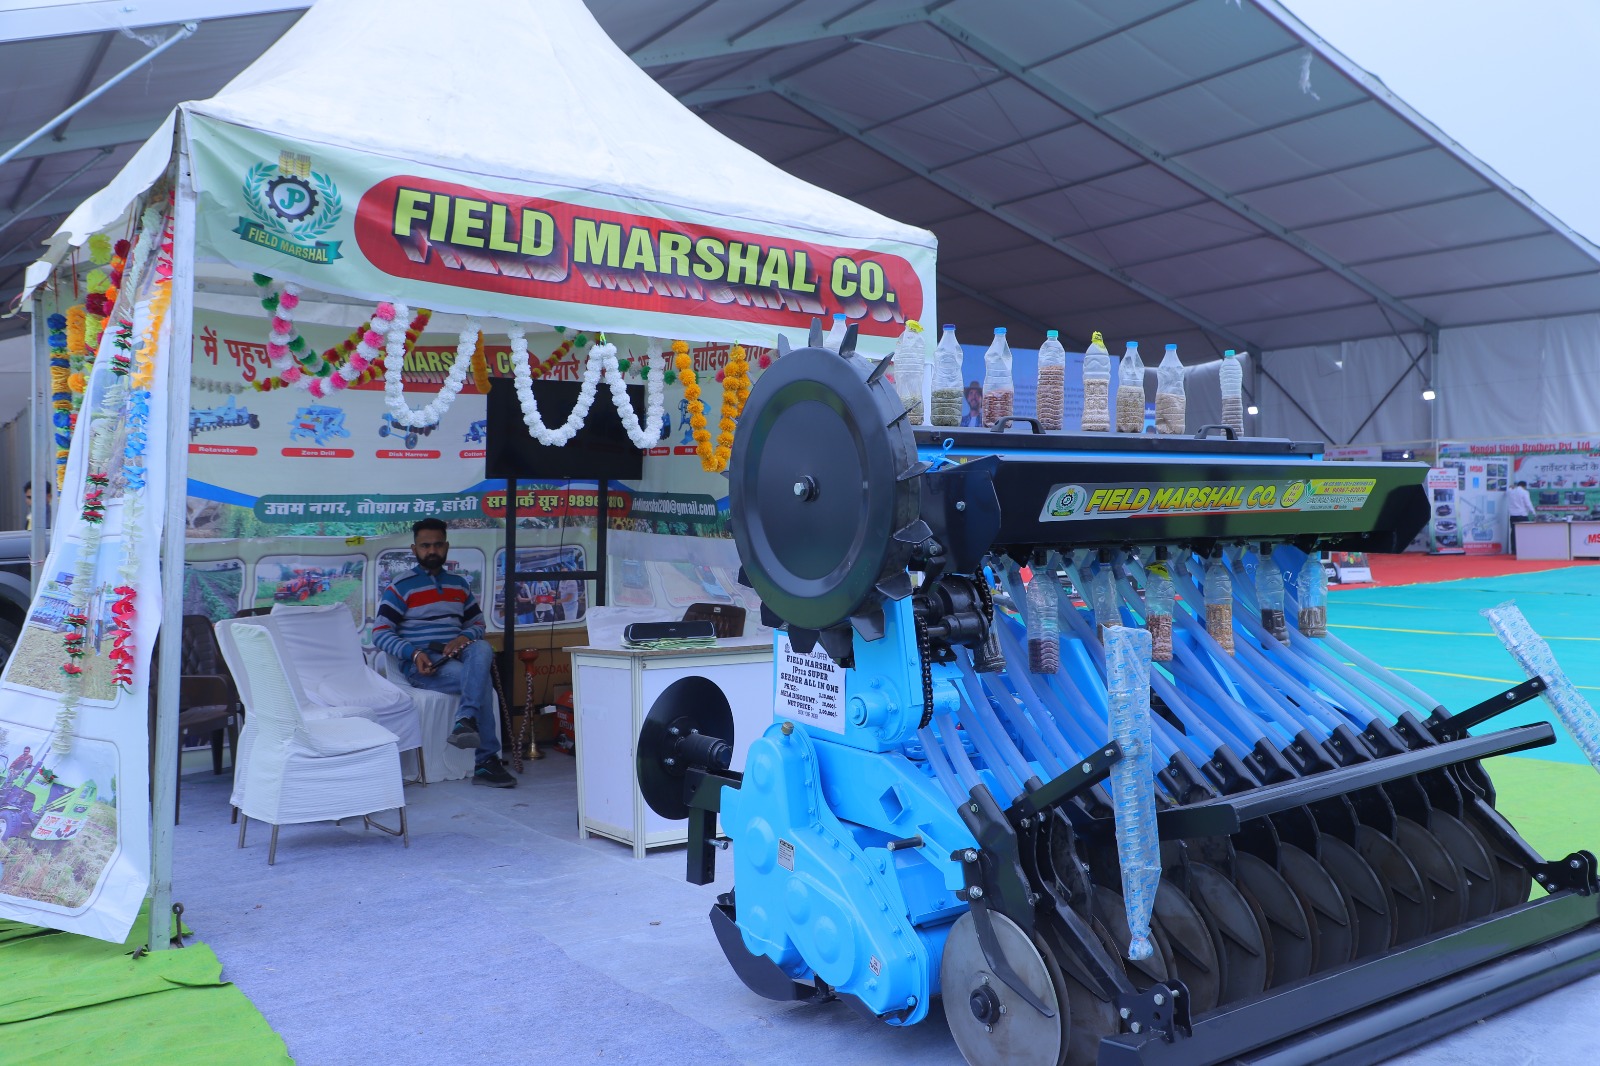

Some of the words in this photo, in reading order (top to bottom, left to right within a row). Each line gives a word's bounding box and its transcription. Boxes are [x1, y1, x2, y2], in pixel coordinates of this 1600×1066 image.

[279, 186, 306, 211] JP
[247, 226, 279, 248] FIELD
[280, 239, 329, 263] MARSHAL
[393, 187, 556, 259] FIELD
[573, 218, 816, 294] MARSHAL
[830, 256, 896, 304] CO.
[1522, 442, 1556, 453] Brothers
[264, 502, 306, 516] उत्तम
[309, 502, 352, 517] नगर,
[356, 499, 411, 514] तोशाम
[1085, 487, 1151, 514] FIELD
[1148, 485, 1241, 512] MARSHAL
[1246, 485, 1277, 508] CO.
[786, 654, 804, 666] FIELD
[804, 658, 835, 673] MARSHAL
[780, 672, 803, 685] SEEDER
[803, 678, 817, 688] ALL
[817, 682, 825, 690] IN
[825, 684, 840, 694] ONE
[807, 669, 829, 682] SUPER
[787, 699, 800, 709] NET
